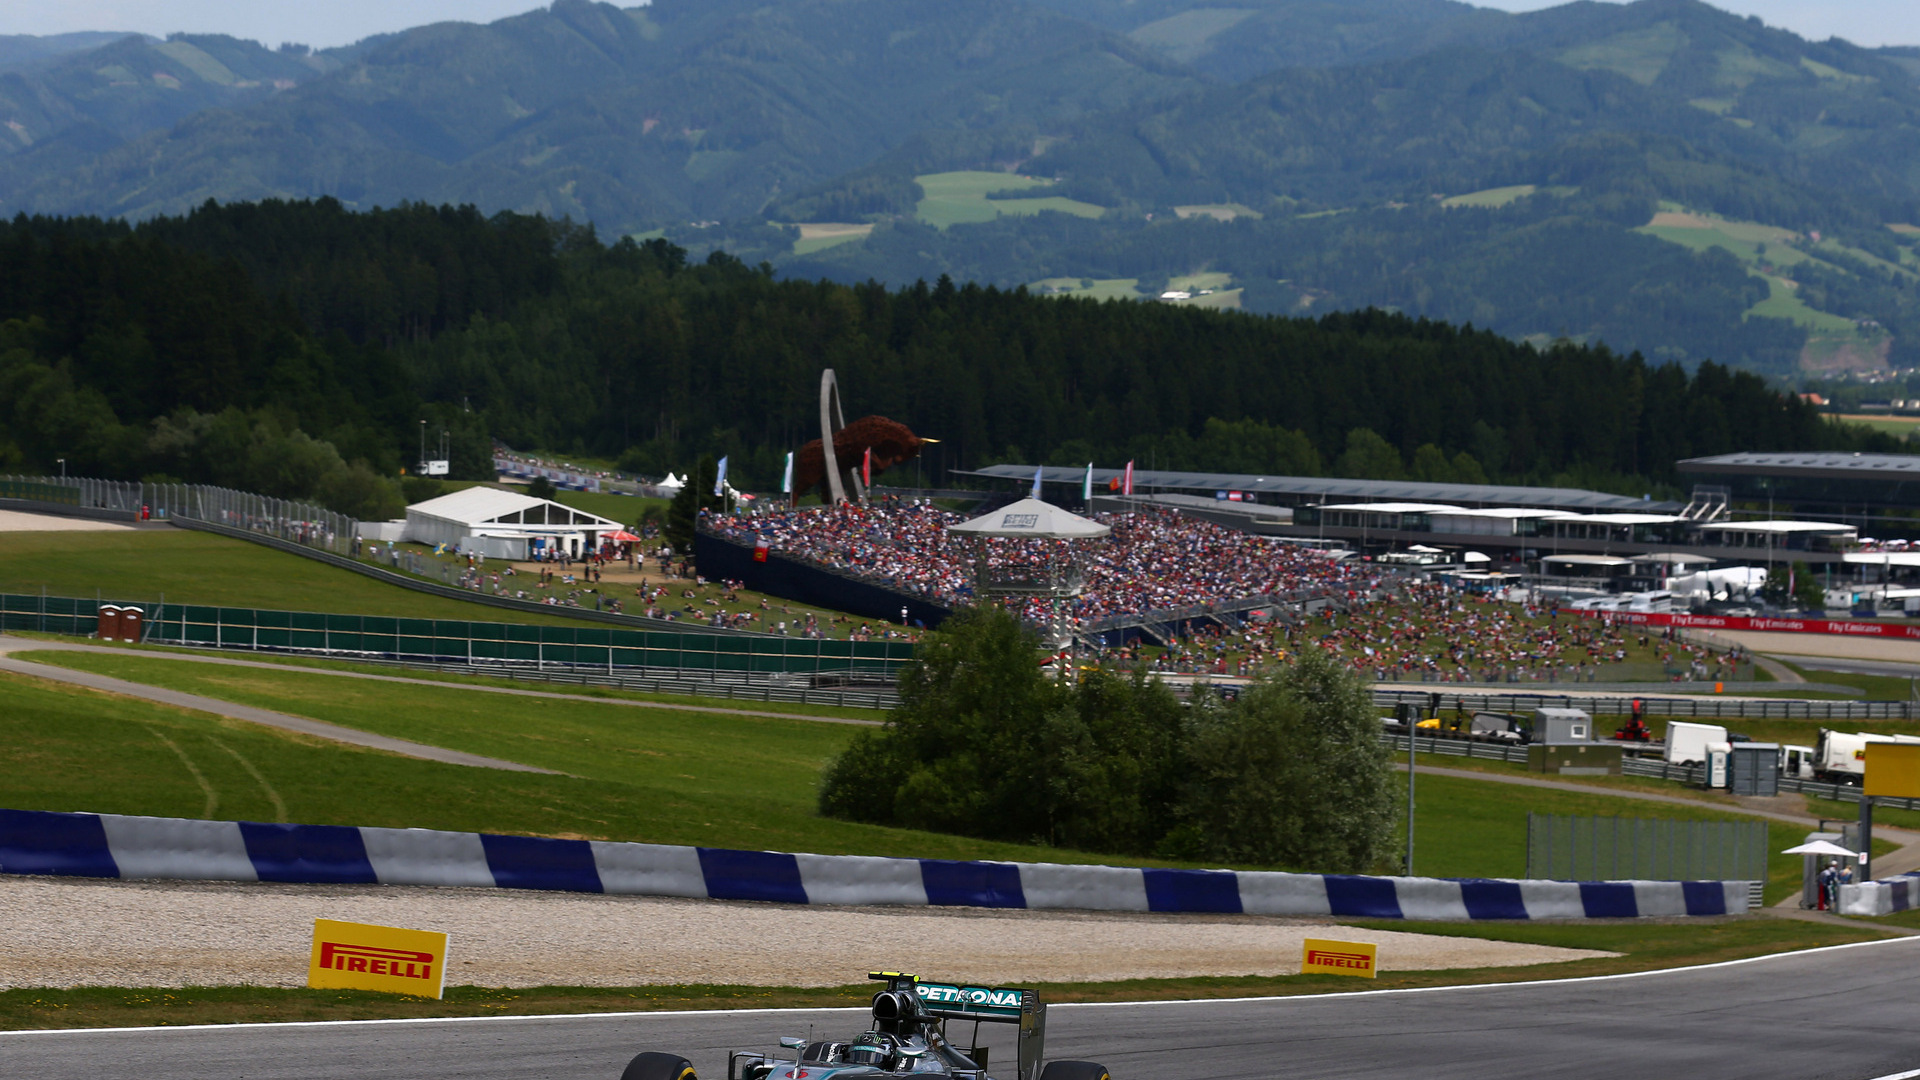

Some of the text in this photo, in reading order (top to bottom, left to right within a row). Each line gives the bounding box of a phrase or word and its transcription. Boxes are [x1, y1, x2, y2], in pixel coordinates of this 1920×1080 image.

[1671, 615, 1725, 626] Fly Emirates
[1750, 618, 1804, 629] Fly Emirates
[1828, 622, 1882, 633] Fly Emirates
[320, 942, 434, 980] PIRELLI
[1307, 949, 1371, 970] PIRELLI
